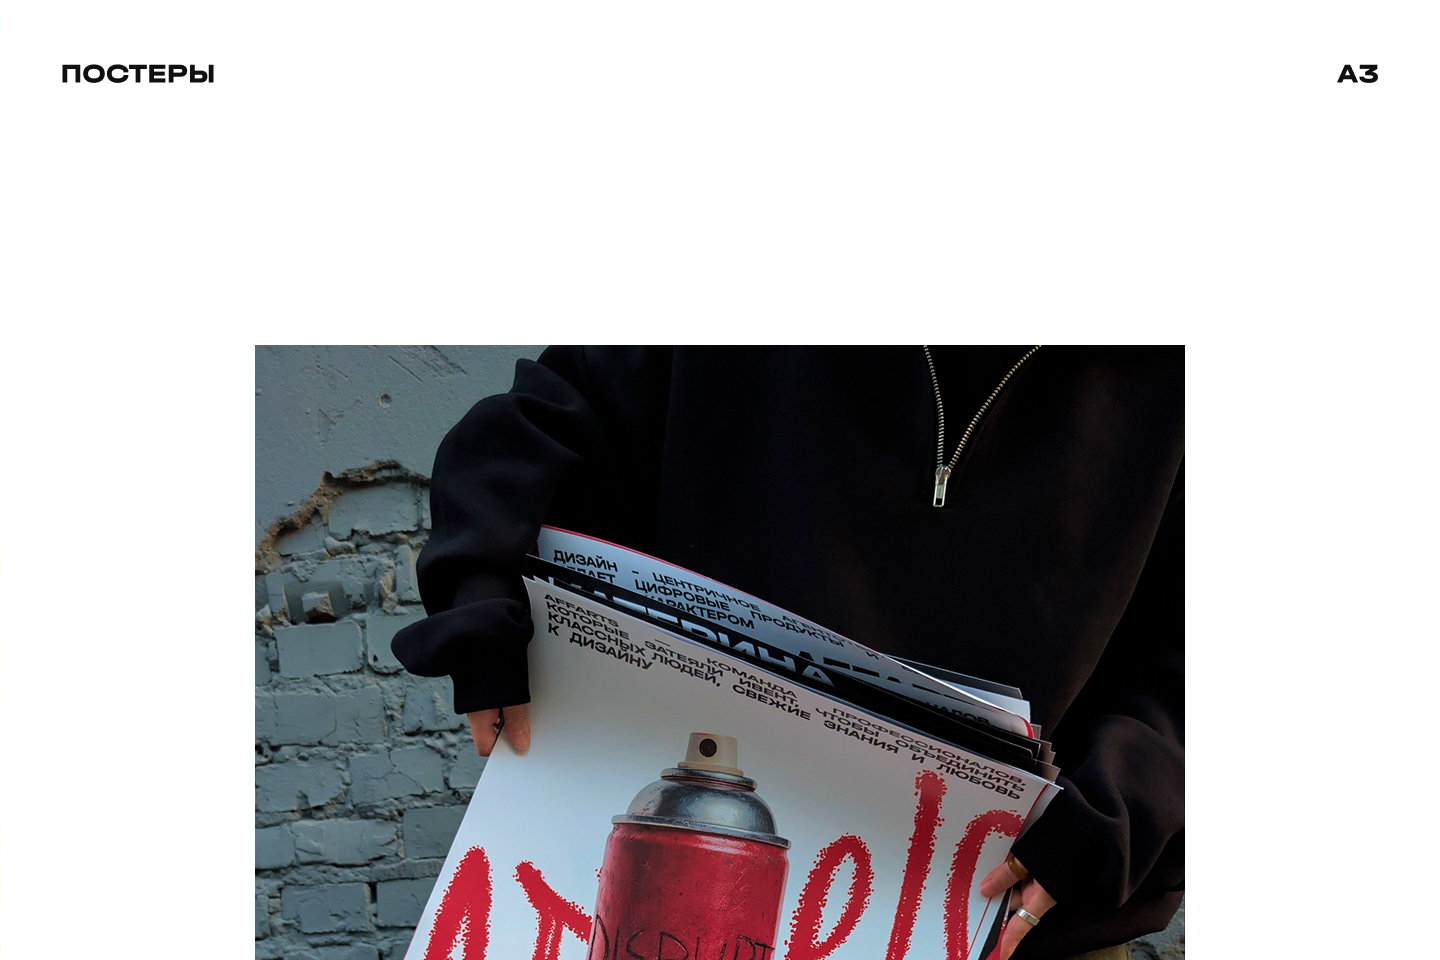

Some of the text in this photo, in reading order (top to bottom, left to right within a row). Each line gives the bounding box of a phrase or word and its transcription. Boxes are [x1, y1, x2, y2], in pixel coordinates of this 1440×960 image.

[553, 549, 619, 573] ДИЗАЙН
[652, 571, 761, 612] ЦЕНТРИЧНОЕ
[634, 578, 731, 612] ЦИФРОВЫЕ
[750, 610, 844, 648] ПРОДУКТЫ
[544, 593, 619, 628] AFFARTS
[706, 657, 797, 698] КОМАНДА
[548, 622, 653, 670] К ДИЗАЙНУ
[546, 601, 630, 640] КОТОРЫЕ
[644, 640, 724, 678] ЗАТЕЯЛИ
[739, 677, 800, 708] ИВЕНТ,
[815, 707, 879, 737] ЧТОБЫ
[895, 740, 1025, 792] ОБЪЕДИНИТЬ
[548, 611, 1021, 800] КЛАССНЫХ ЛЮДЕЙ, СВЕЖИЕ ЗНАНИЯ И ЛЮБОВЬ
